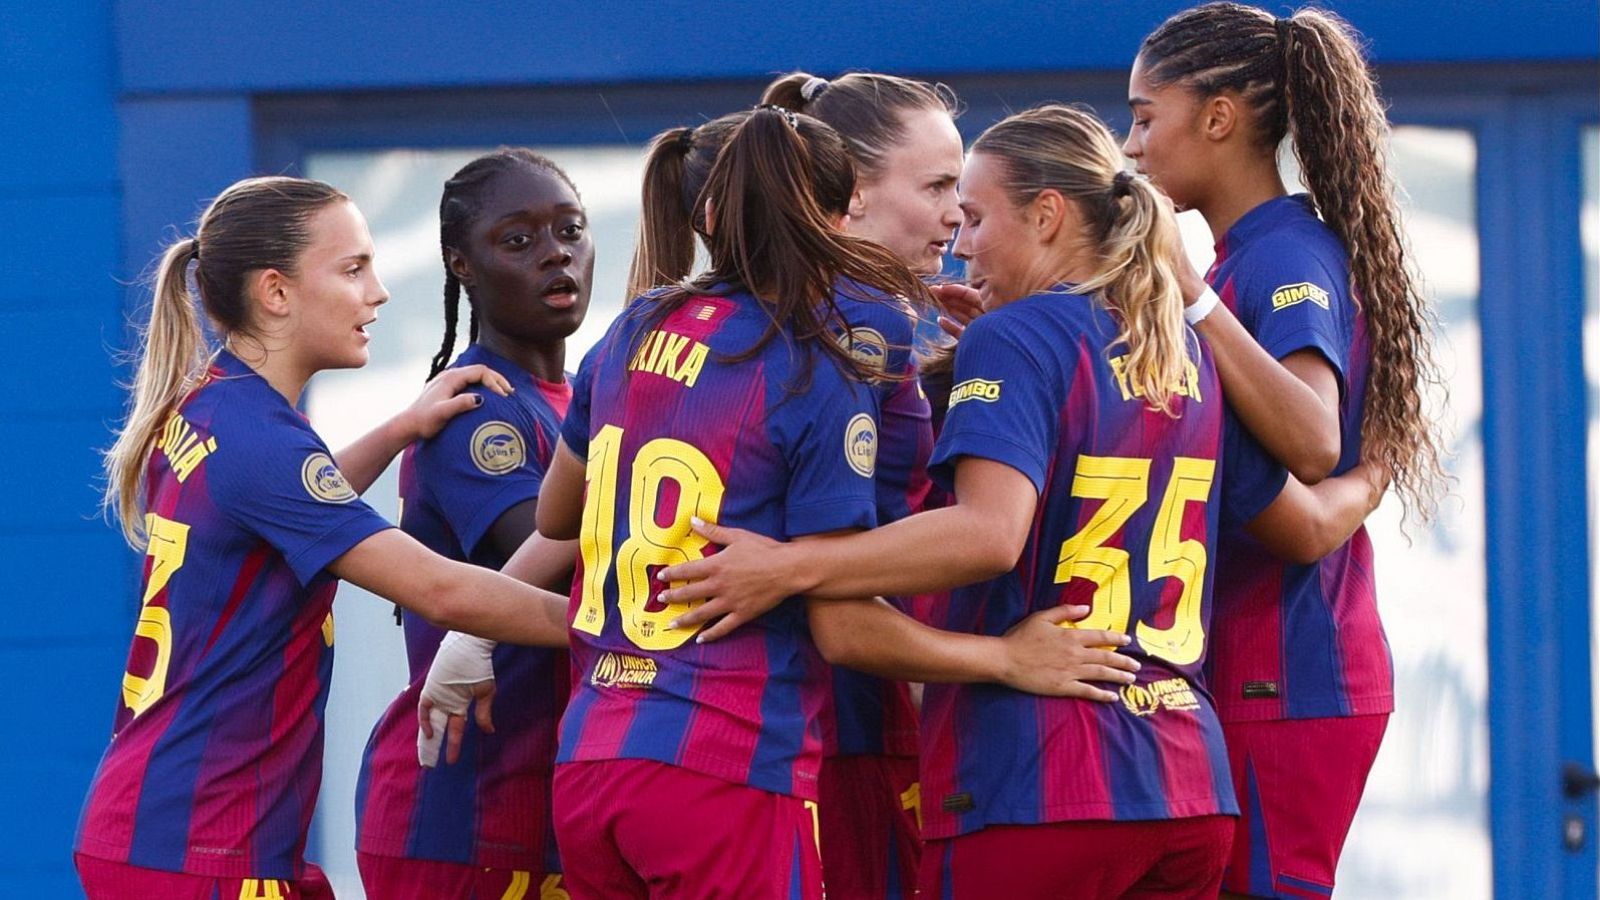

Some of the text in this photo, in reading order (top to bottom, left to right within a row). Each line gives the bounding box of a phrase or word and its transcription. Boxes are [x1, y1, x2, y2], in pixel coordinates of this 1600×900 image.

[1272, 284, 1329, 308] BIMBO
[949, 381, 1000, 406] BIMBO
[571, 423, 725, 651] 18
[1053, 454, 1216, 665] 35
[621, 654, 657, 671] UNHCR
[617, 669, 656, 684] ACNUR
[1148, 677, 1191, 696] UNHCR
